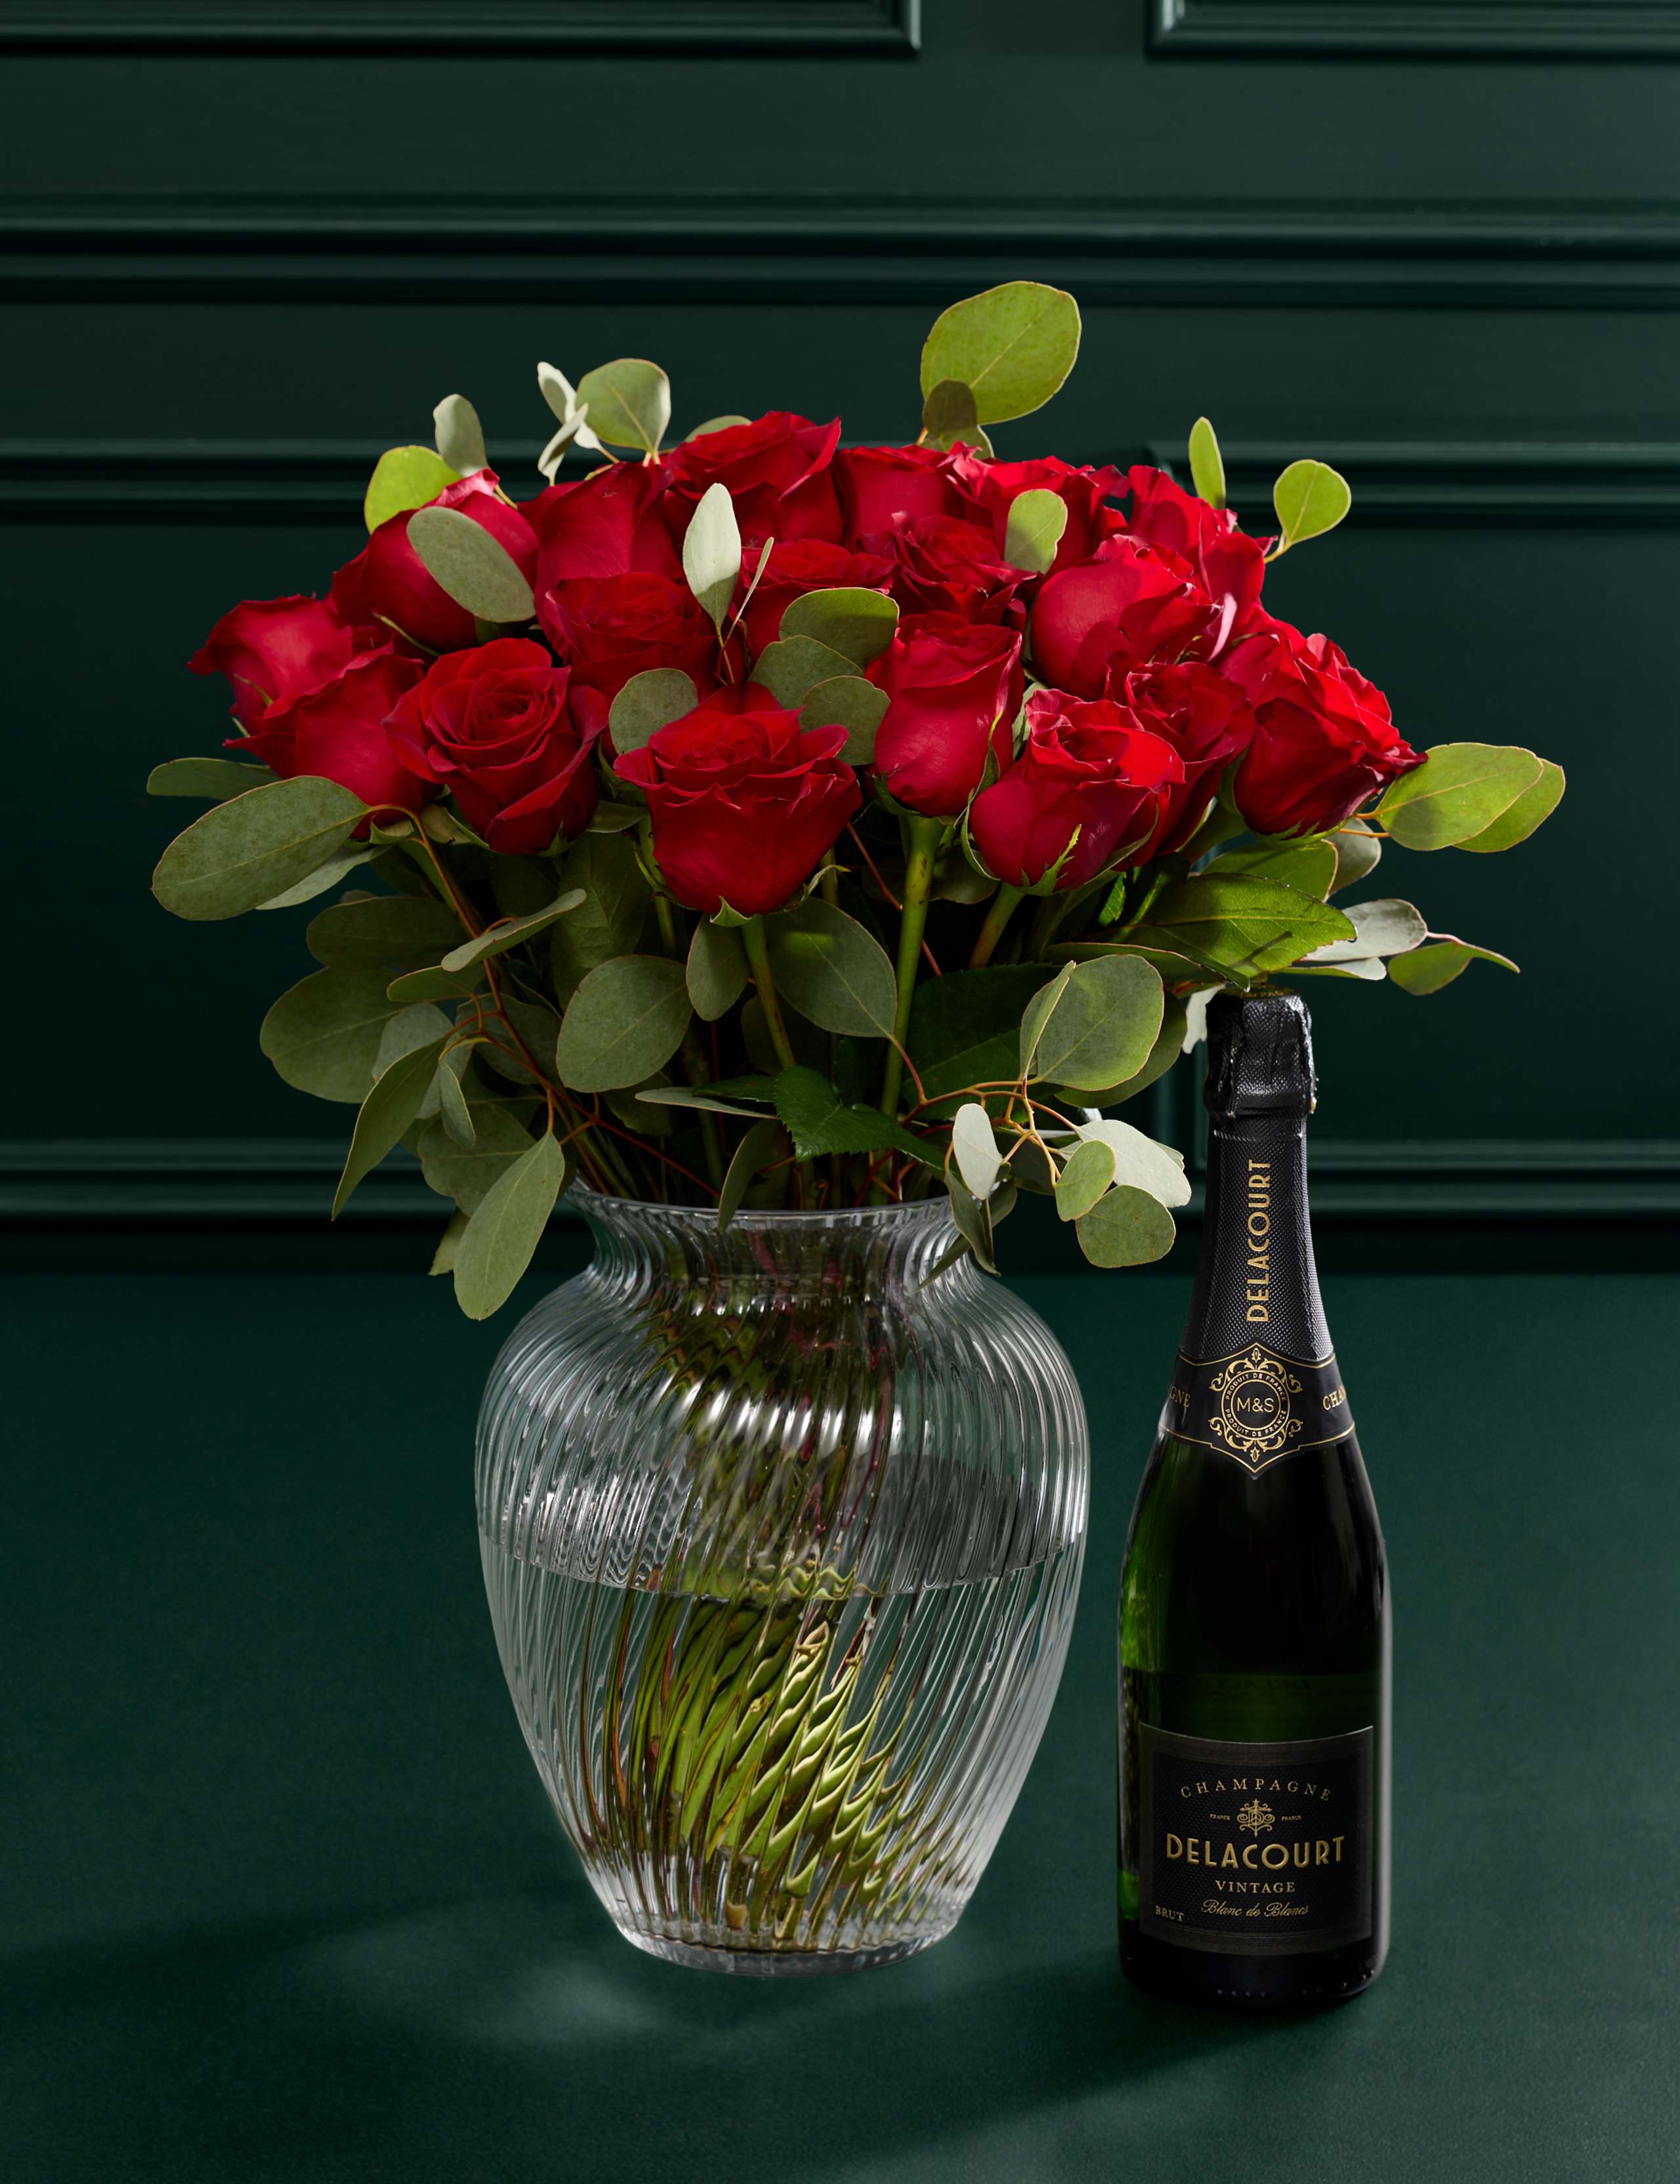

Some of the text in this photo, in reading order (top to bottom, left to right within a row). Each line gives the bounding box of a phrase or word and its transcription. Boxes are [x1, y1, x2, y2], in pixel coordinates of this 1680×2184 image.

[1246, 1159, 1270, 1322] DELACOURT
[1225, 1373, 1250, 1400] PRODUIT
[1265, 1375, 1287, 1400] FRANCE
[1236, 1397, 1274, 1413] M&S
[1225, 1408, 1250, 1435] PRODUIT
[1265, 1410, 1287, 1435] FRANCE
[1180, 1778, 1332, 1801] CHAMPAGNE
[1166, 1832, 1345, 1870] DELACOURT
[1215, 1880, 1297, 1894] VINTAGE
[1155, 1905, 1185, 1922] BRUT
[1201, 1899, 1310, 1917] Blanc de Blancs
